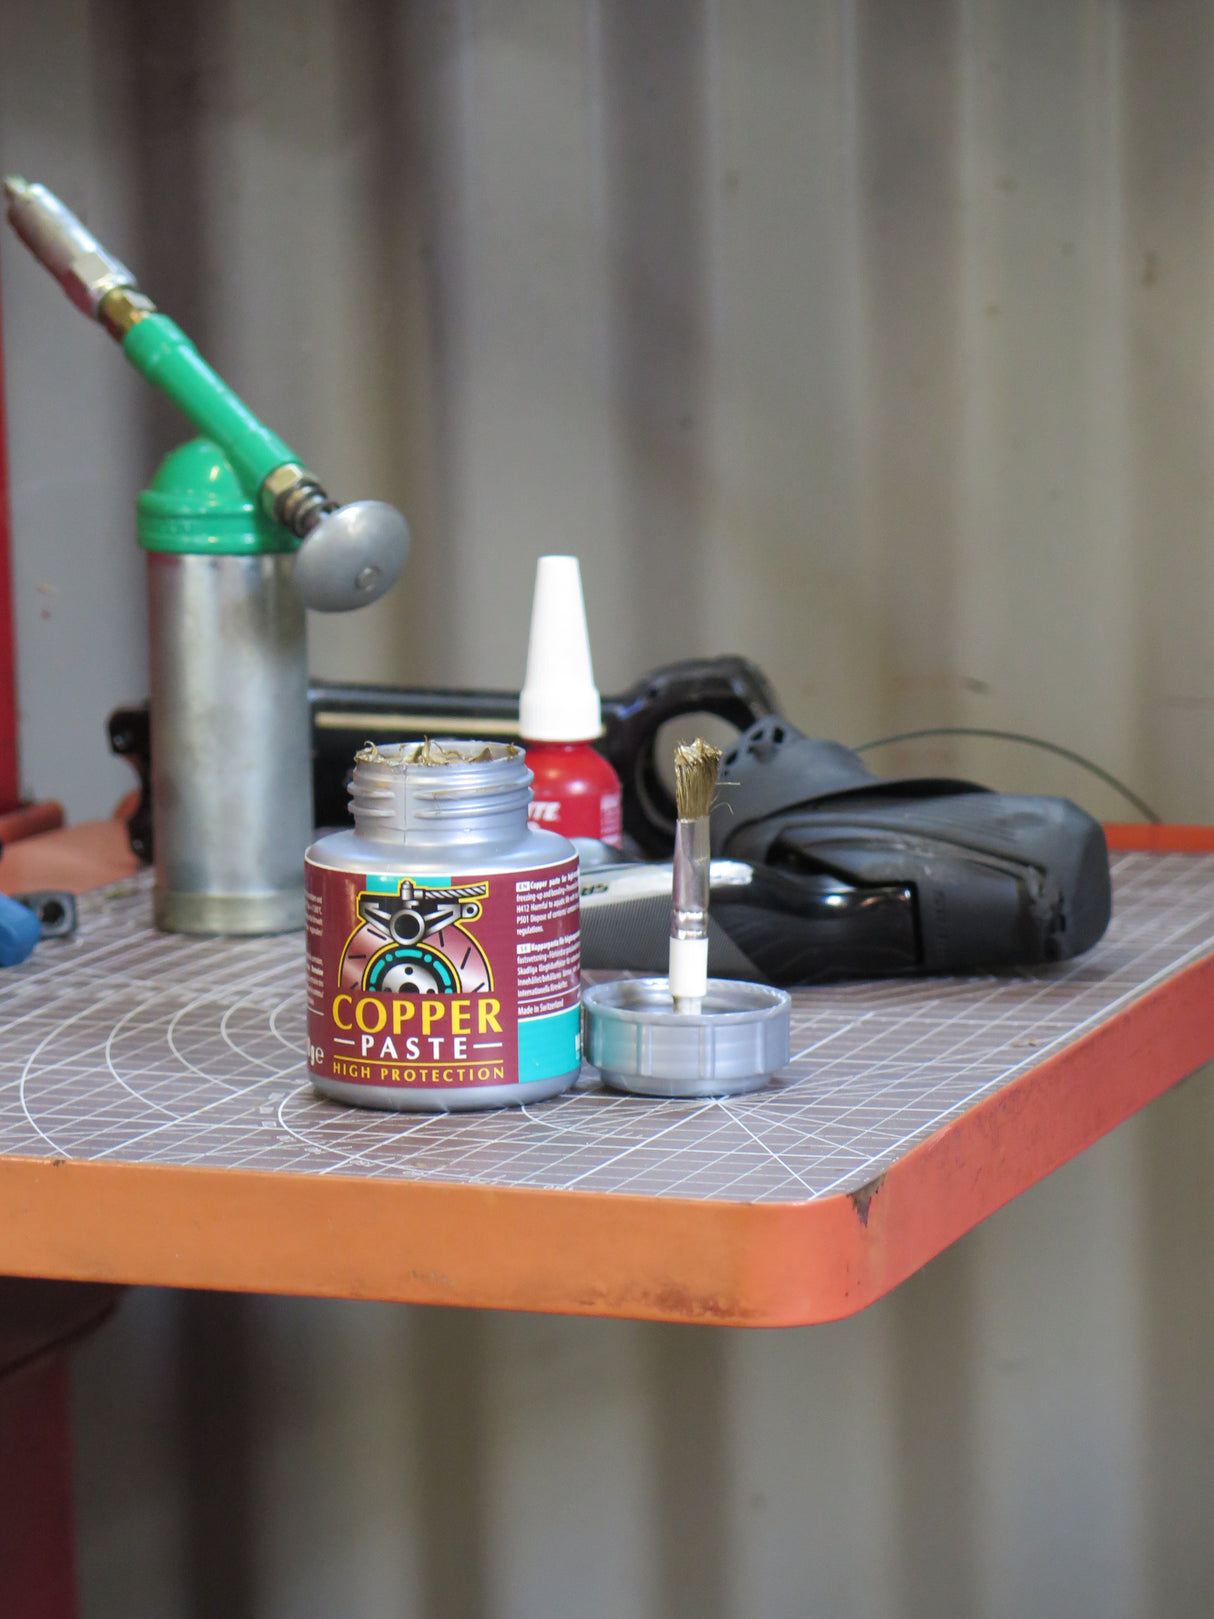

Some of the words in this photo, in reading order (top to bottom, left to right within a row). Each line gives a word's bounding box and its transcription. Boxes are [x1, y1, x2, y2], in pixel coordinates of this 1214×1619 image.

[530, 880, 548, 891] Copper
[516, 904, 530, 914] H412
[516, 915, 529, 925] P501
[332, 994, 503, 1036] COPPER
[517, 1005, 533, 1017] Made
[533, 1004, 540, 1014] in
[540, 998, 564, 1012] Switzerland
[361, 1034, 467, 1060] PASTE
[333, 1061, 371, 1079] HIGH
[380, 1067, 504, 1082] PROTECTION
